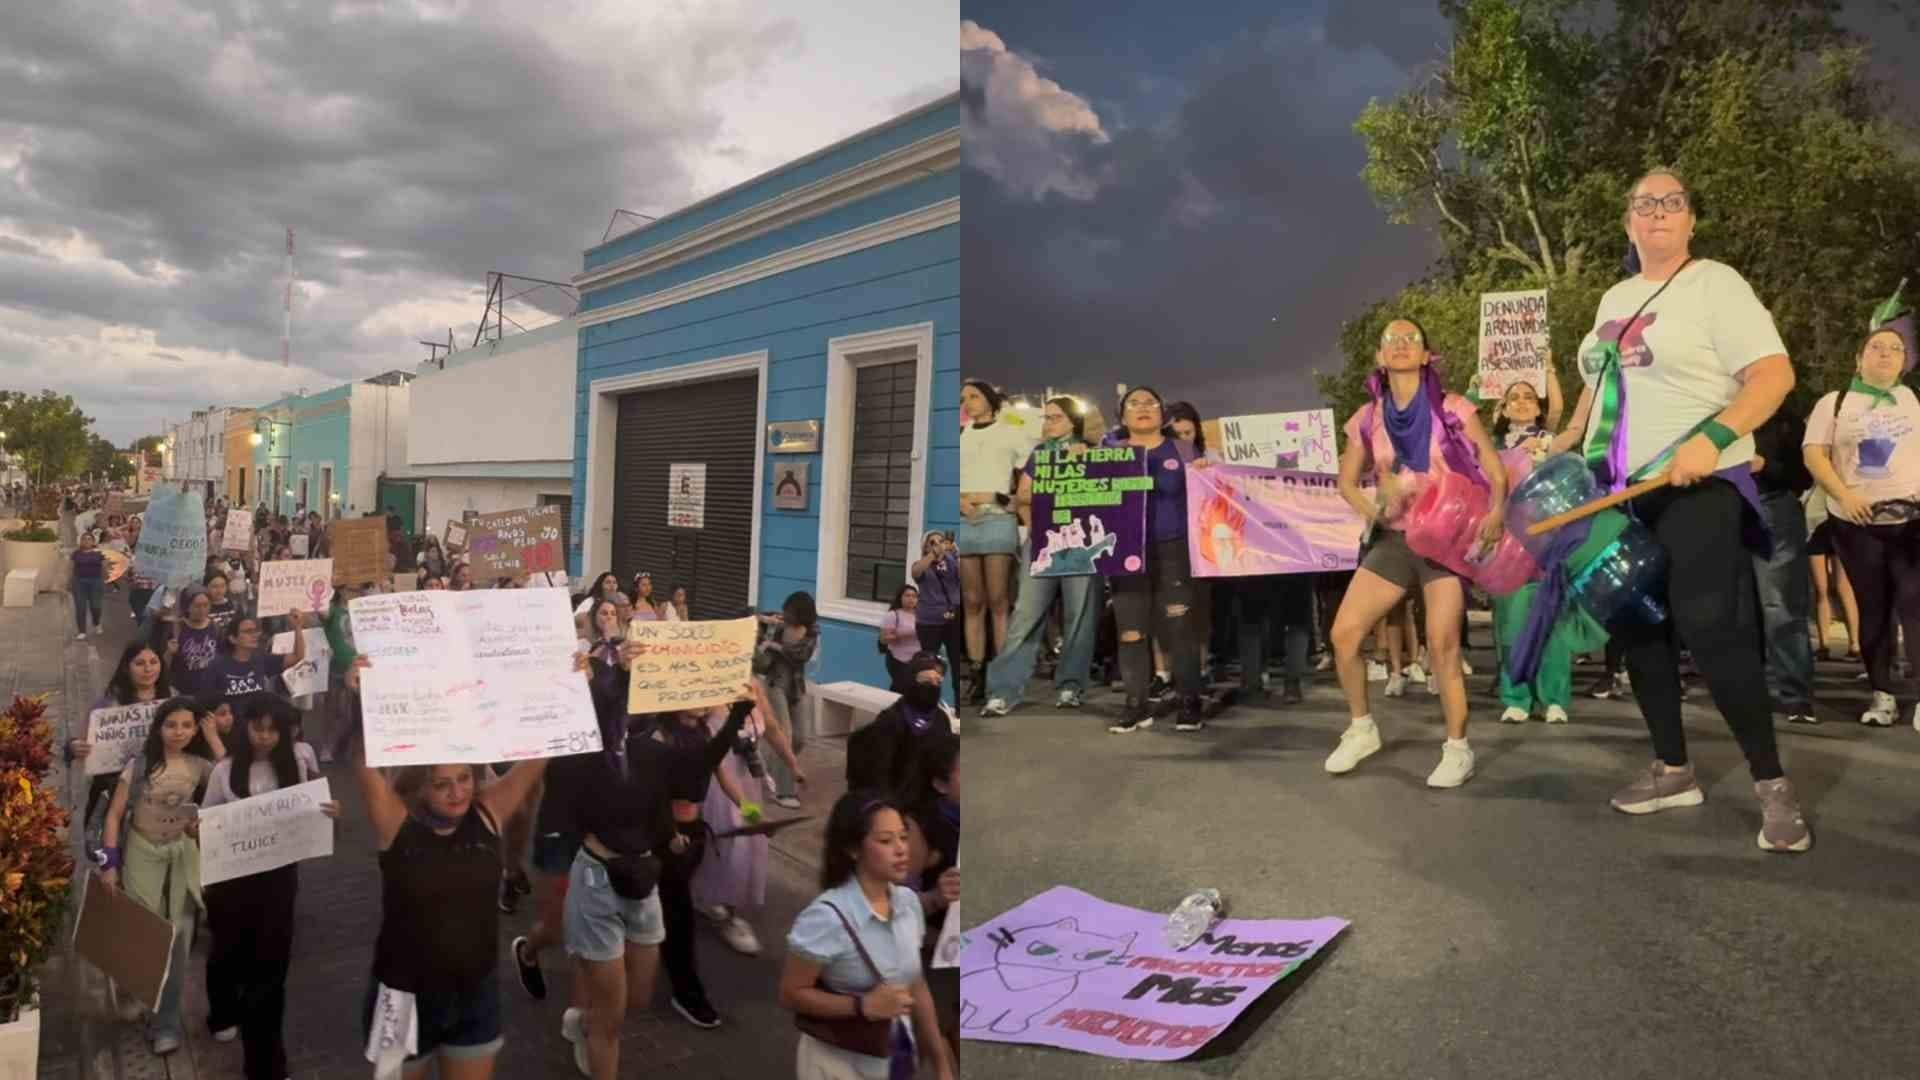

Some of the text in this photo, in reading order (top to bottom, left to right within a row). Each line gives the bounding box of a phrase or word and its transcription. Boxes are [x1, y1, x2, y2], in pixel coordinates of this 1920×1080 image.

[1494, 338, 1535, 357] MUJER
[1225, 421, 1241, 441] NI
[1227, 443, 1260, 461] UNA
[1034, 463, 1086, 479] NI LAS
[1177, 931, 1315, 958] Menos
[1122, 972, 1248, 1007] Más
